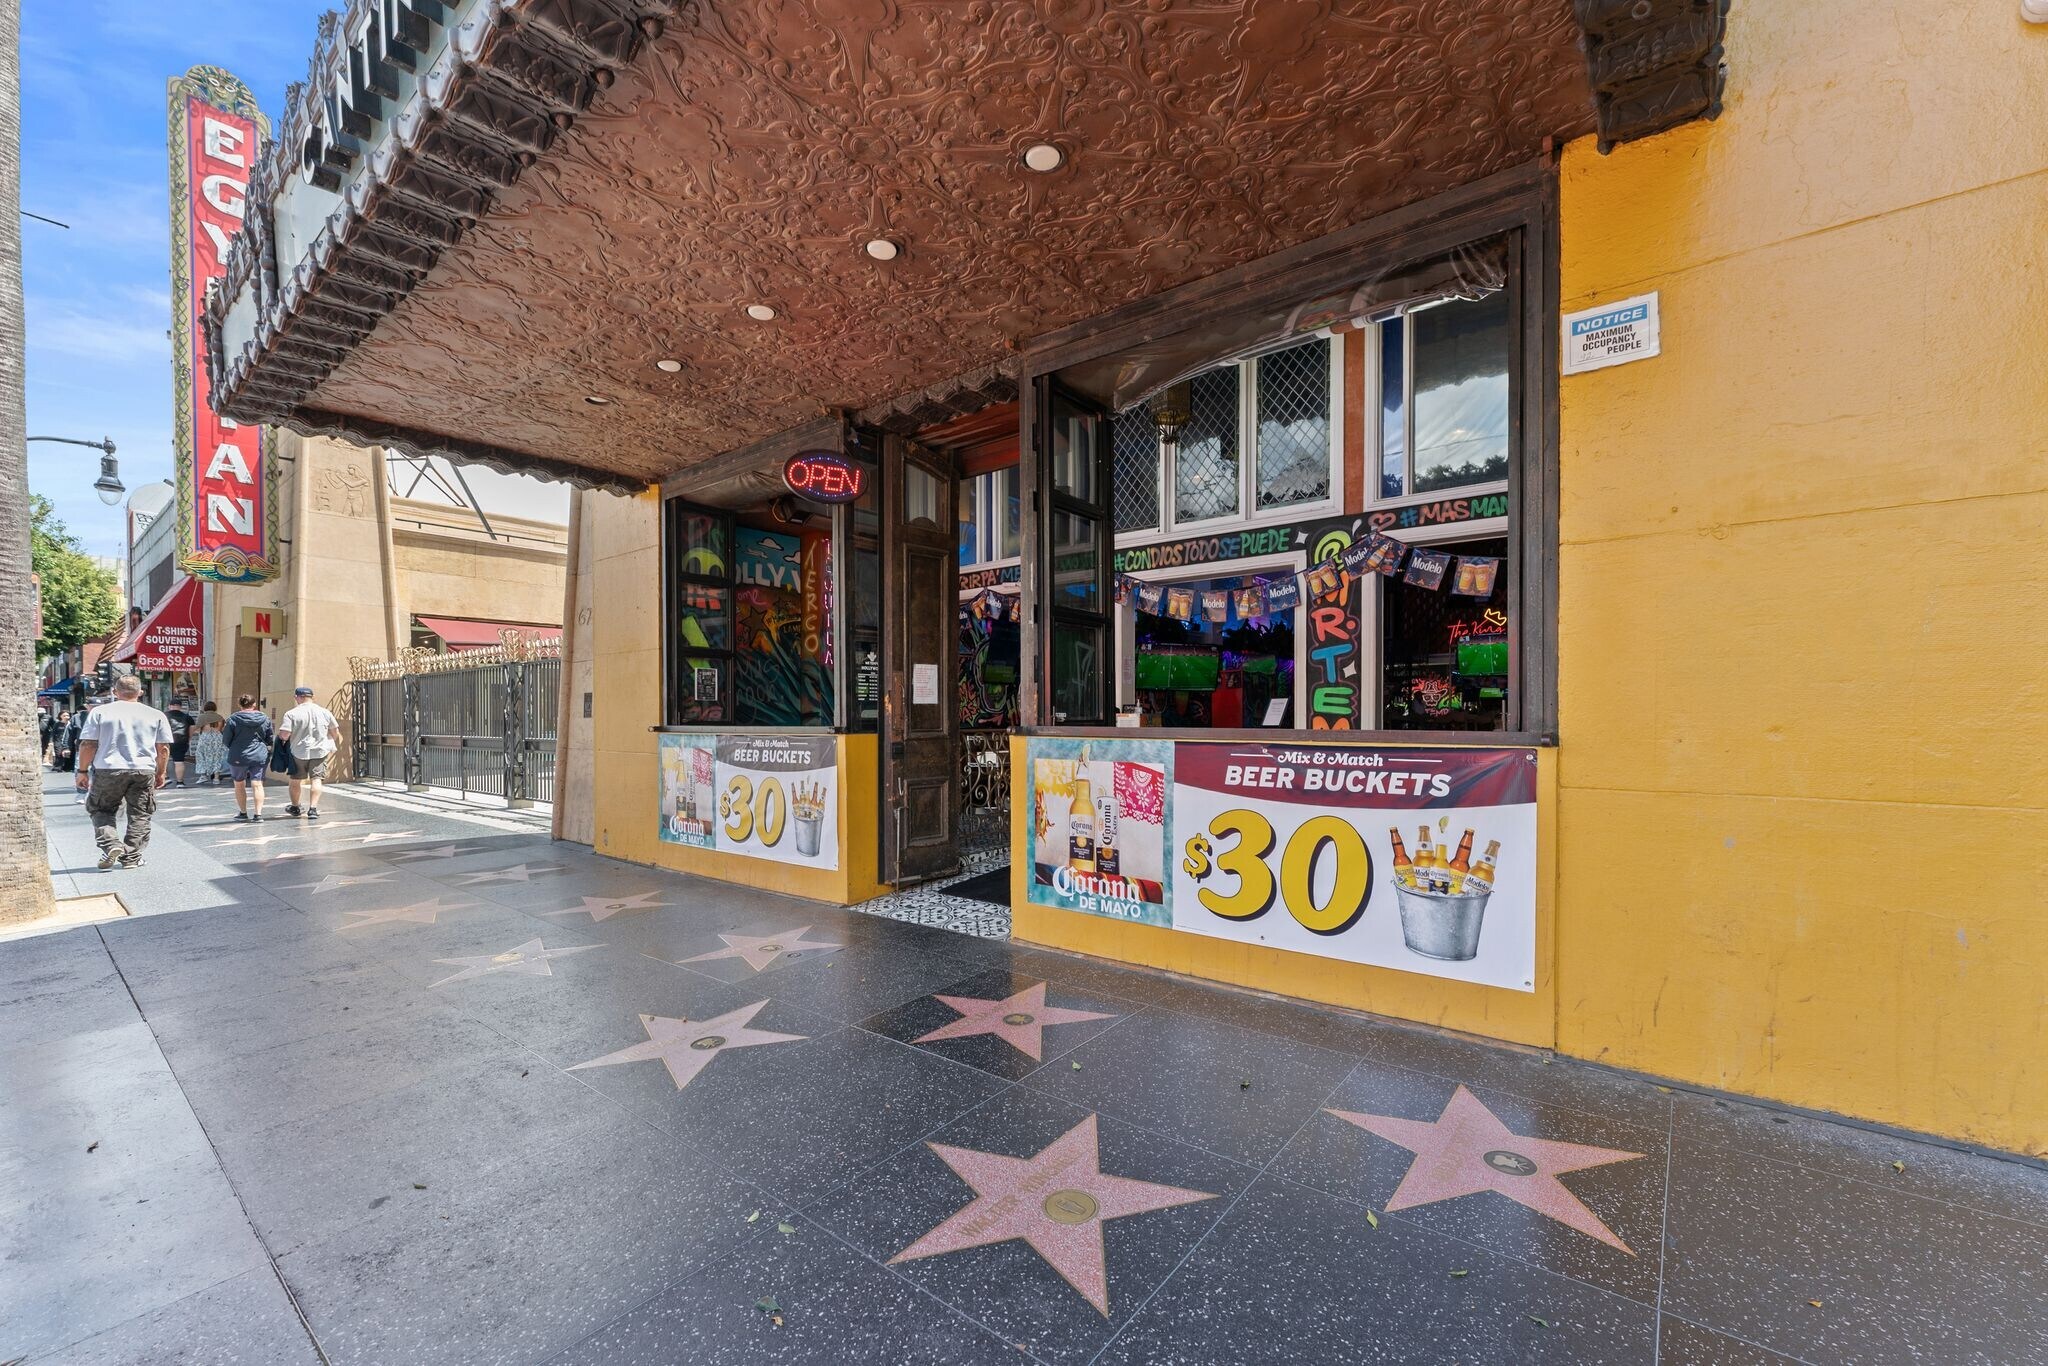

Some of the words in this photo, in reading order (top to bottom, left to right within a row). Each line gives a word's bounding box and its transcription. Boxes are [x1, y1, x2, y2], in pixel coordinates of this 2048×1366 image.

[200, 116, 255, 537] EGYAN
[1577, 308, 1643, 332] NOTICE
[1582, 332, 1637, 352] OCCUPANCY
[1585, 324, 1633, 342] MAXIMUM
[1606, 340, 1642, 355] PEOPLE
[788, 461, 861, 494] OPEN
[1114, 527, 1291, 572] #CONDIOSTODOSEPUEDE
[1345, 547, 1368, 567] Model
[1412, 557, 1443, 575] Modelo
[1139, 587, 1160, 602] Modelo
[1269, 585, 1296, 599] Modelo
[1202, 598, 1226, 609] Modelo
[156, 626, 198, 637] T-SHIRTS
[255, 612, 271, 634] N
[1447, 619, 1469, 645] The
[146, 635, 198, 646] SOUVENIRS
[158, 645, 186, 655] GIFTS
[167, 655, 202, 669] $9.99
[753, 740, 764, 748] Mix
[769, 740, 790, 748] Match
[734, 749, 760, 763] BEER
[762, 749, 812, 765] BUCKETS
[1277, 751, 1310, 765] Mix
[1313, 751, 1325, 765] &
[1327, 751, 1384, 767] Match
[1224, 765, 1296, 790] BEER
[1303, 768, 1452, 798] BUCKETS
[720, 775, 786, 848] $30
[669, 815, 705, 837] Corona
[1071, 820, 1093, 831] Corona
[1102, 804, 1113, 846] Corona
[1182, 808, 1374, 936] $30
[1052, 865, 1142, 903] Corona
[1079, 895, 1098, 911] DE
[1100, 899, 1142, 918] MAYO
